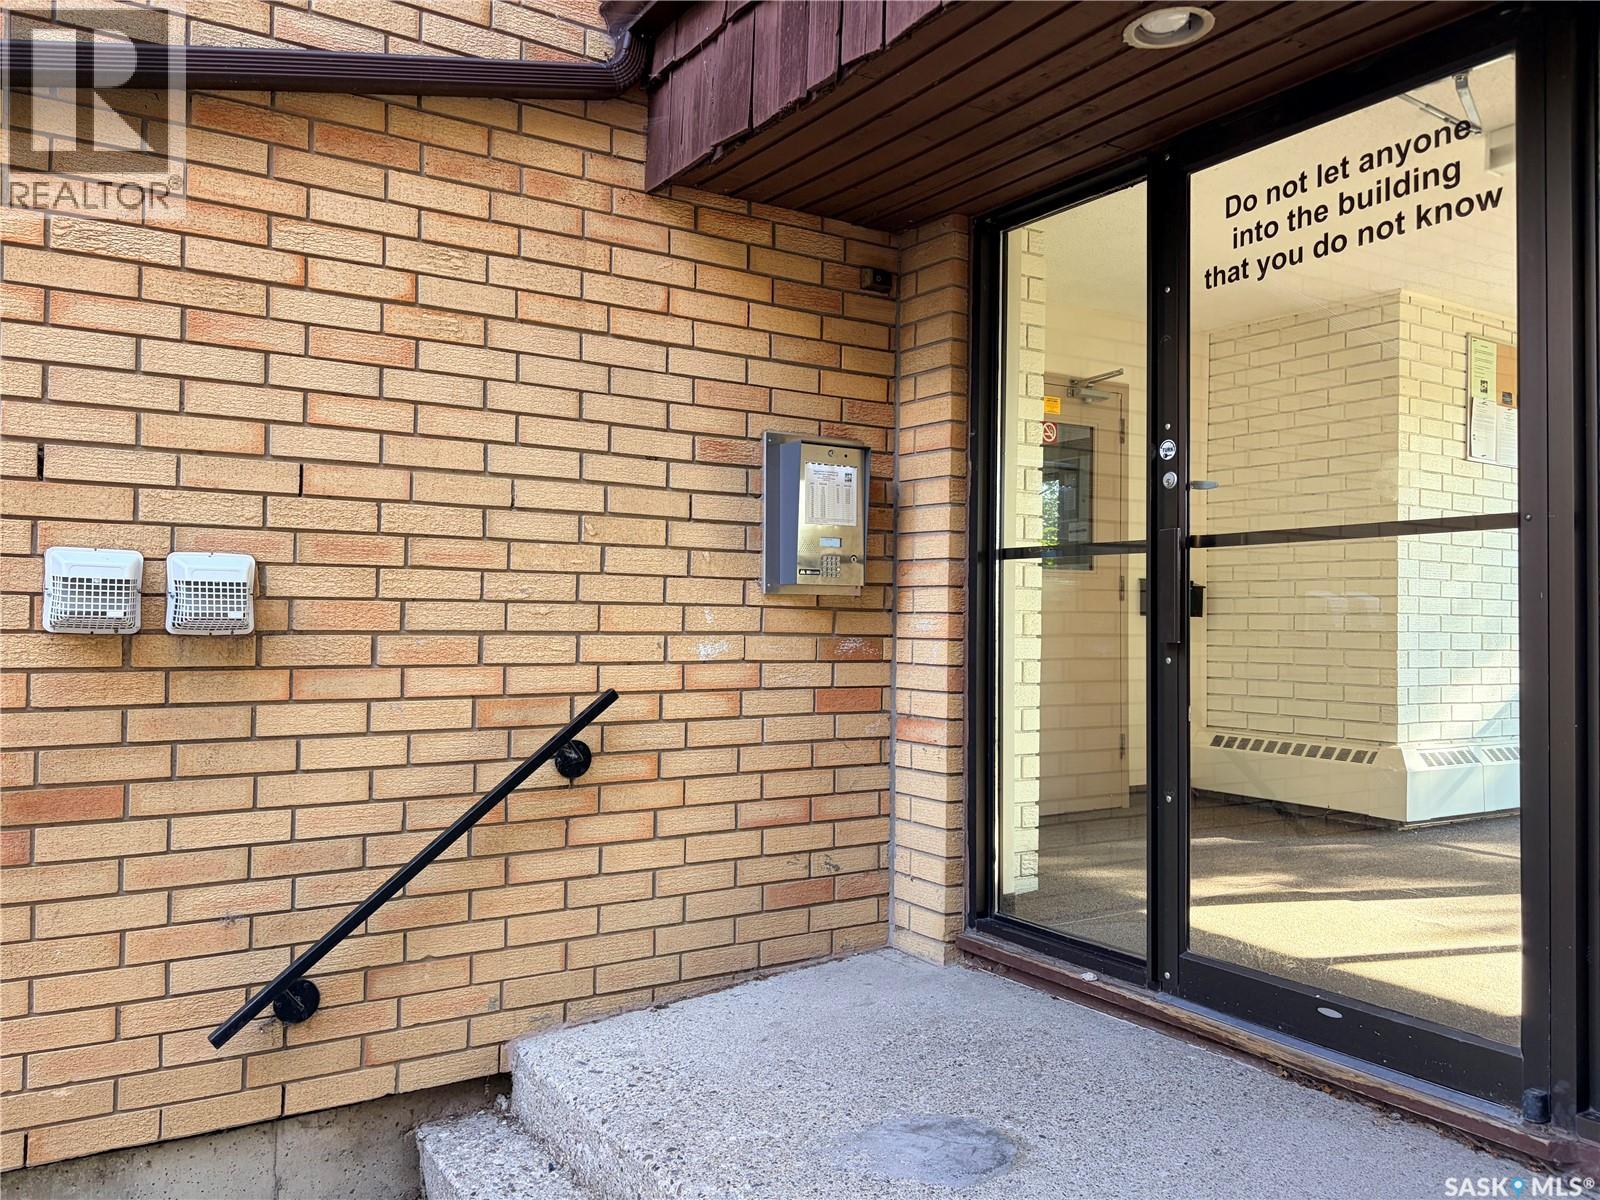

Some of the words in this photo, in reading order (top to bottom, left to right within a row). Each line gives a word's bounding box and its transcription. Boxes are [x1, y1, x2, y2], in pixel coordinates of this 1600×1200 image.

[1224, 194, 1258, 219] Do
[1266, 170, 1308, 205] not
[1316, 155, 1350, 188] let
[1358, 119, 1472, 174] anyone
[1232, 219, 1279, 250] into
[1286, 203, 1329, 232] the
[1338, 160, 1462, 217] building
[1203, 257, 1250, 290] that
[1256, 245, 1304, 282] you
[1312, 232, 1348, 259] do
[1357, 210, 1406, 247] not
[1415, 186, 1504, 230] know
